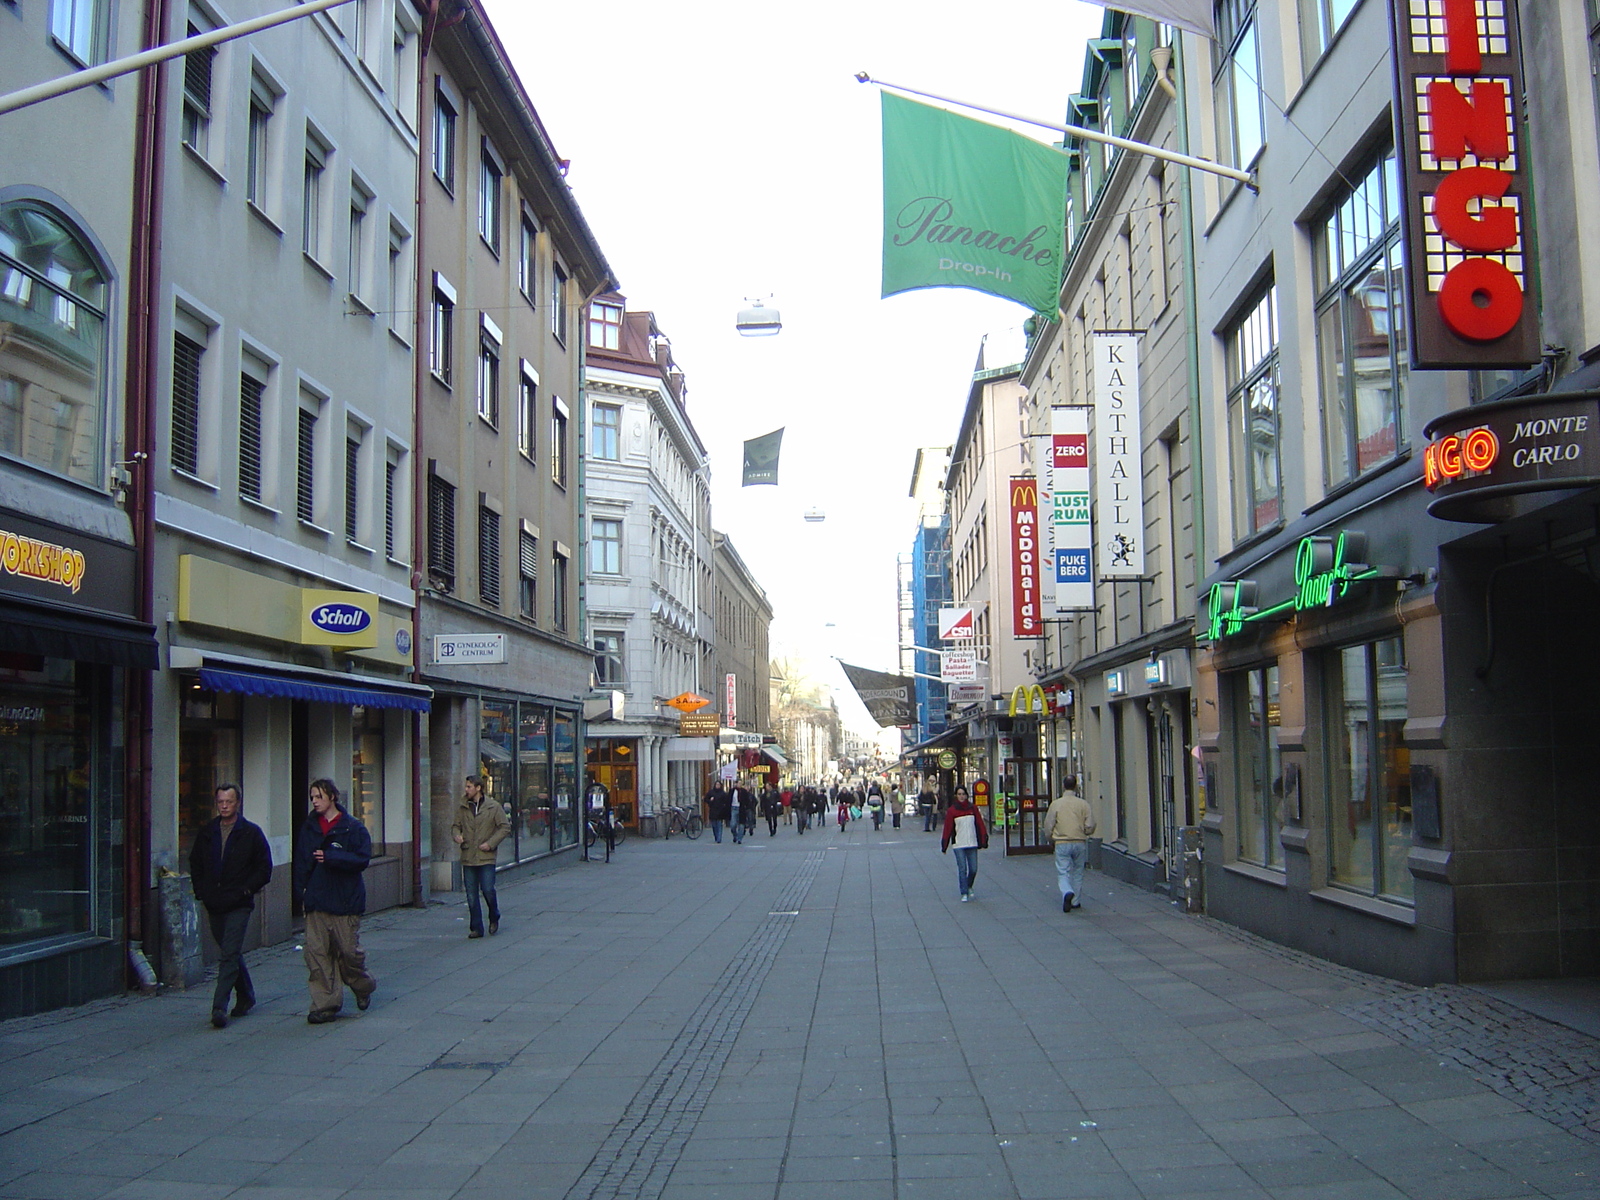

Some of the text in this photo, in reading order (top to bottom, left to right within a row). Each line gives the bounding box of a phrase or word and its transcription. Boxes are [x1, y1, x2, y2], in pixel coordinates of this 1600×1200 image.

[893, 196, 1052, 267] Panache
[938, 257, 1012, 283] Drop-In
[1107, 345, 1131, 524] KASTHALL
[1509, 416, 1588, 444] MONTE
[1055, 446, 1085, 456] ZERO
[1512, 443, 1580, 468] CARLO
[1054, 496, 1089, 507] LUST
[1054, 509, 1090, 519] RUM
[1060, 555, 1086, 565] PUKE
[1016, 511, 1034, 630] McDonalds
[1060, 565, 1087, 576] BERG
[317, 608, 363, 626] Scholl
[951, 626, 972, 637] csn
[456, 641, 499, 649] GYNEKOLOG
